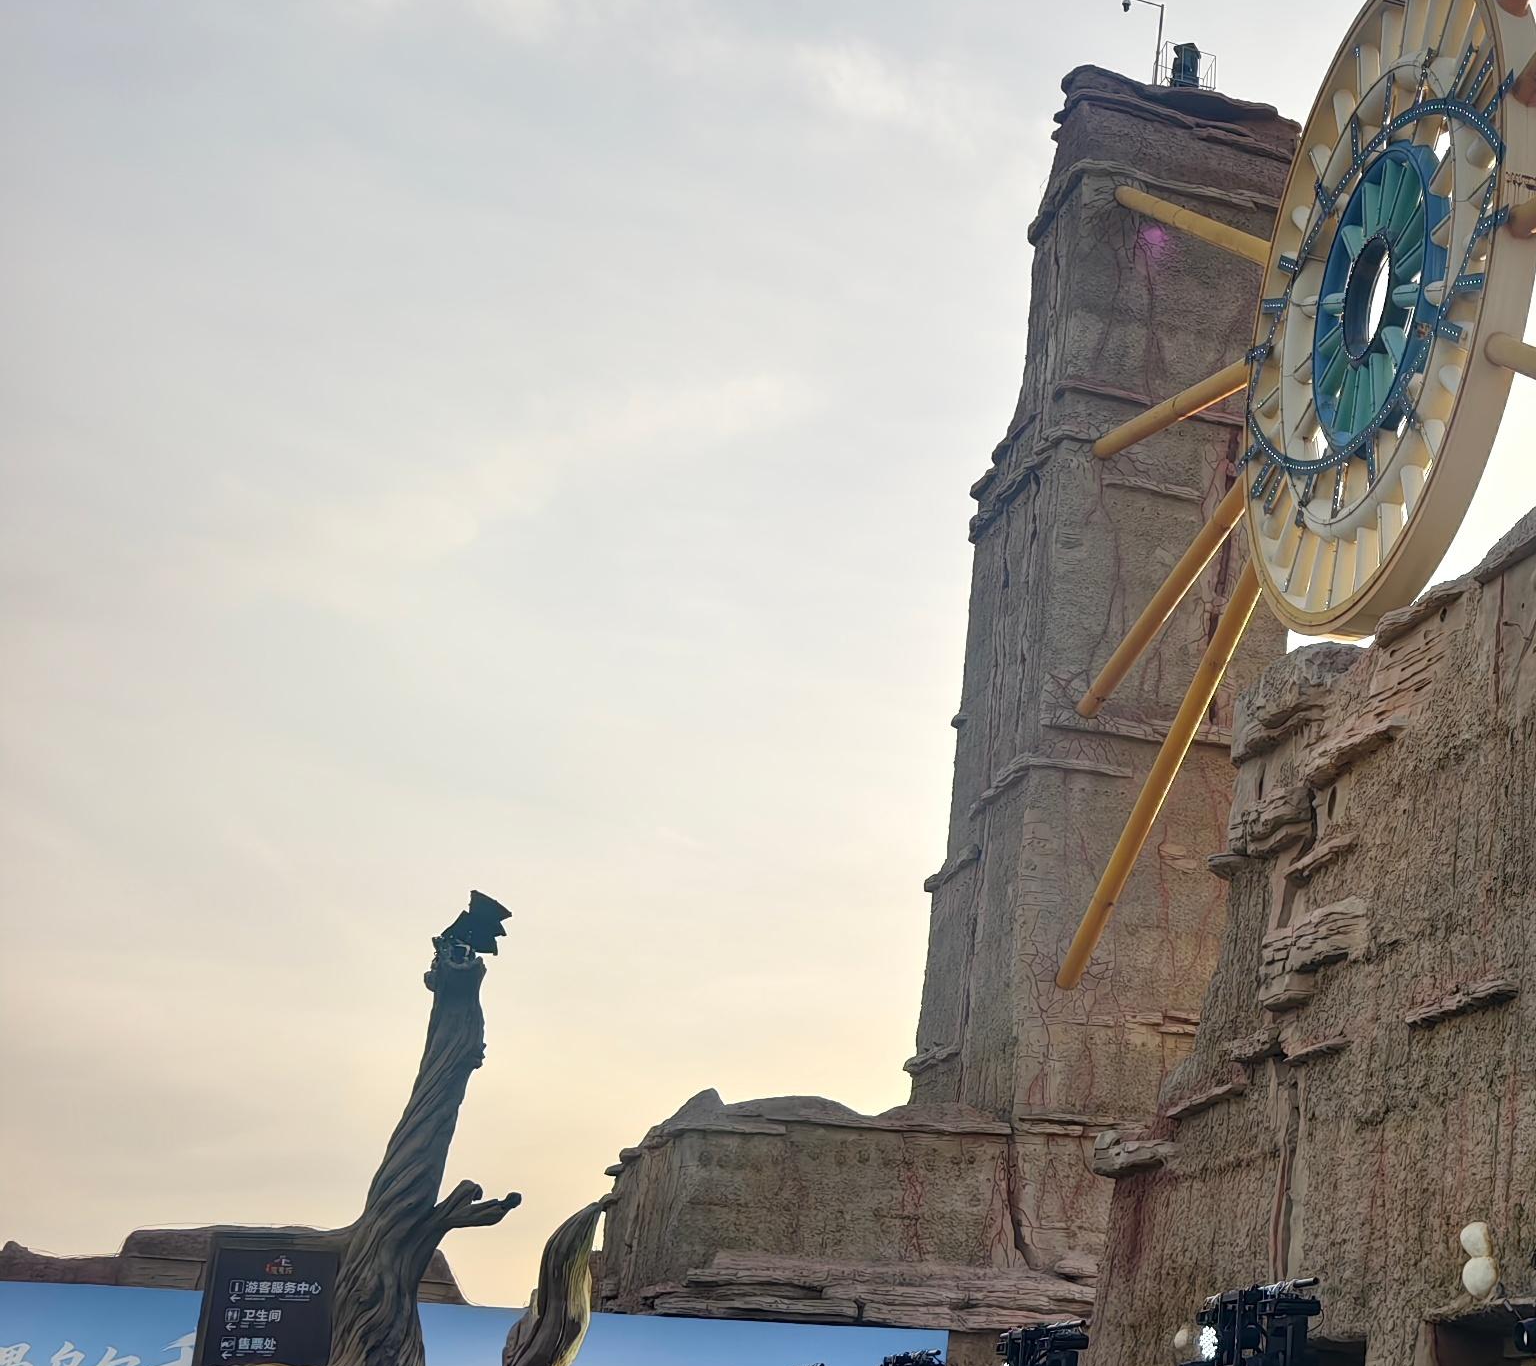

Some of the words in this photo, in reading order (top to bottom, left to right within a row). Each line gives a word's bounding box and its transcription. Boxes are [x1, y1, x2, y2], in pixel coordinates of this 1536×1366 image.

[245, 1280, 322, 1295] 游客服务中心
[242, 1309, 282, 1322] 卫生间
[238, 1337, 277, 1350] 售票处
